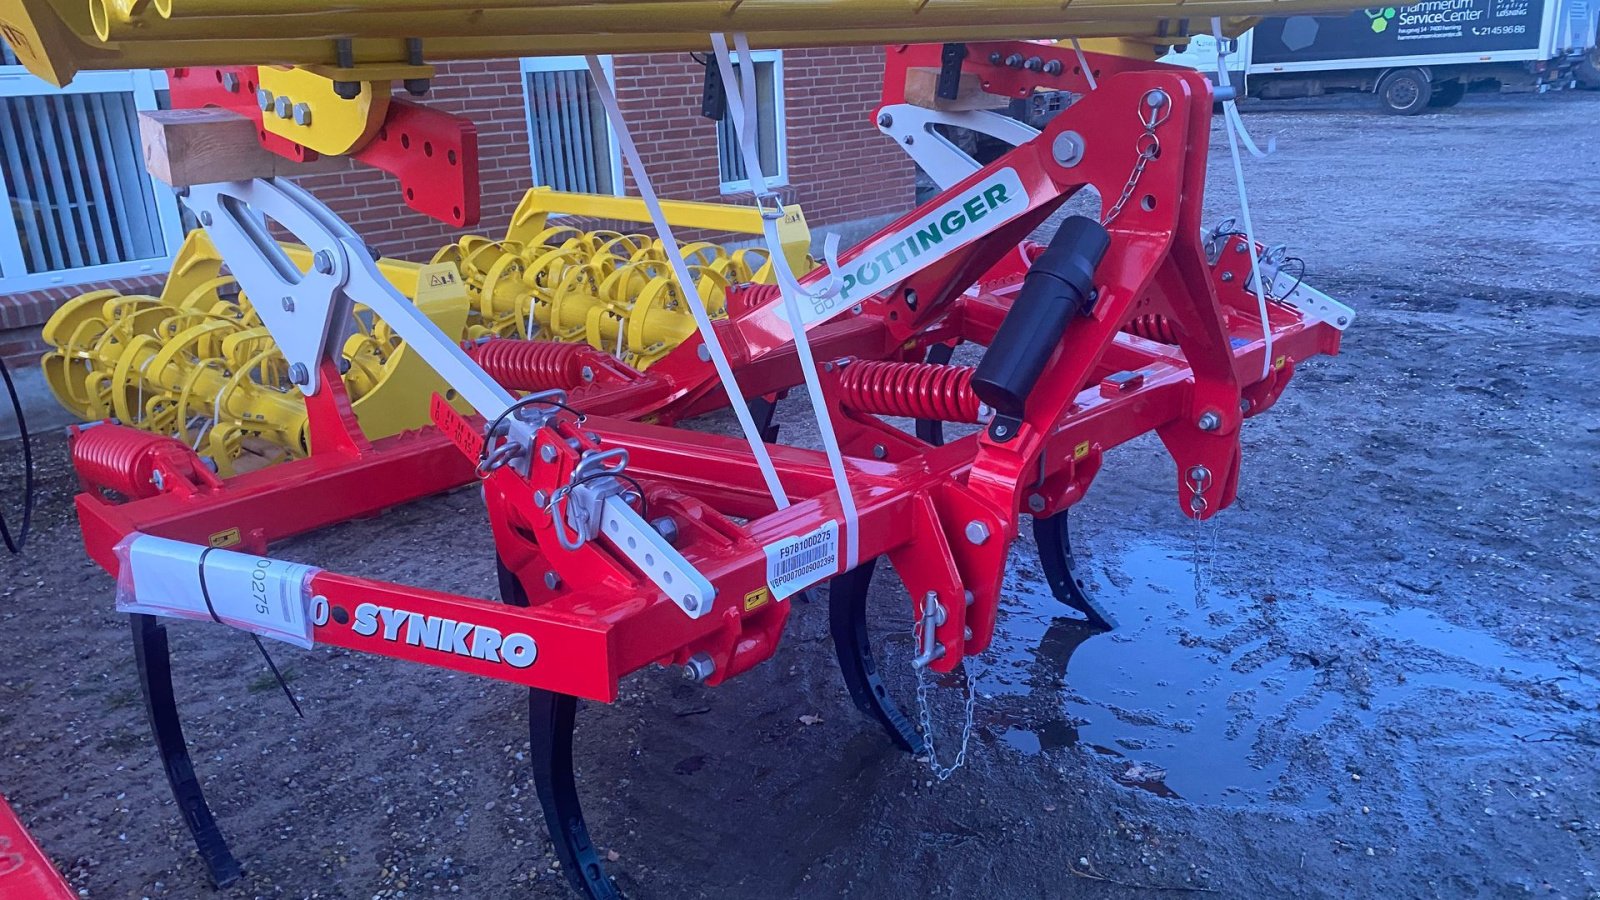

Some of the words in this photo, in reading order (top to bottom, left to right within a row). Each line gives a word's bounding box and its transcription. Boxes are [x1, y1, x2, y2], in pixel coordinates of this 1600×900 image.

[1399, 9, 1483, 25] ServiceCenter
[1481, 27, 1491, 35] 21
[1491, 26, 1502, 35] 45
[1503, 26, 1513, 34] 96
[1514, 25, 1526, 34] 86
[839, 183, 1012, 299] PÖTTINGER
[780, 530, 831, 559] F9781000275
[352, 603, 537, 668] SYNKRO
